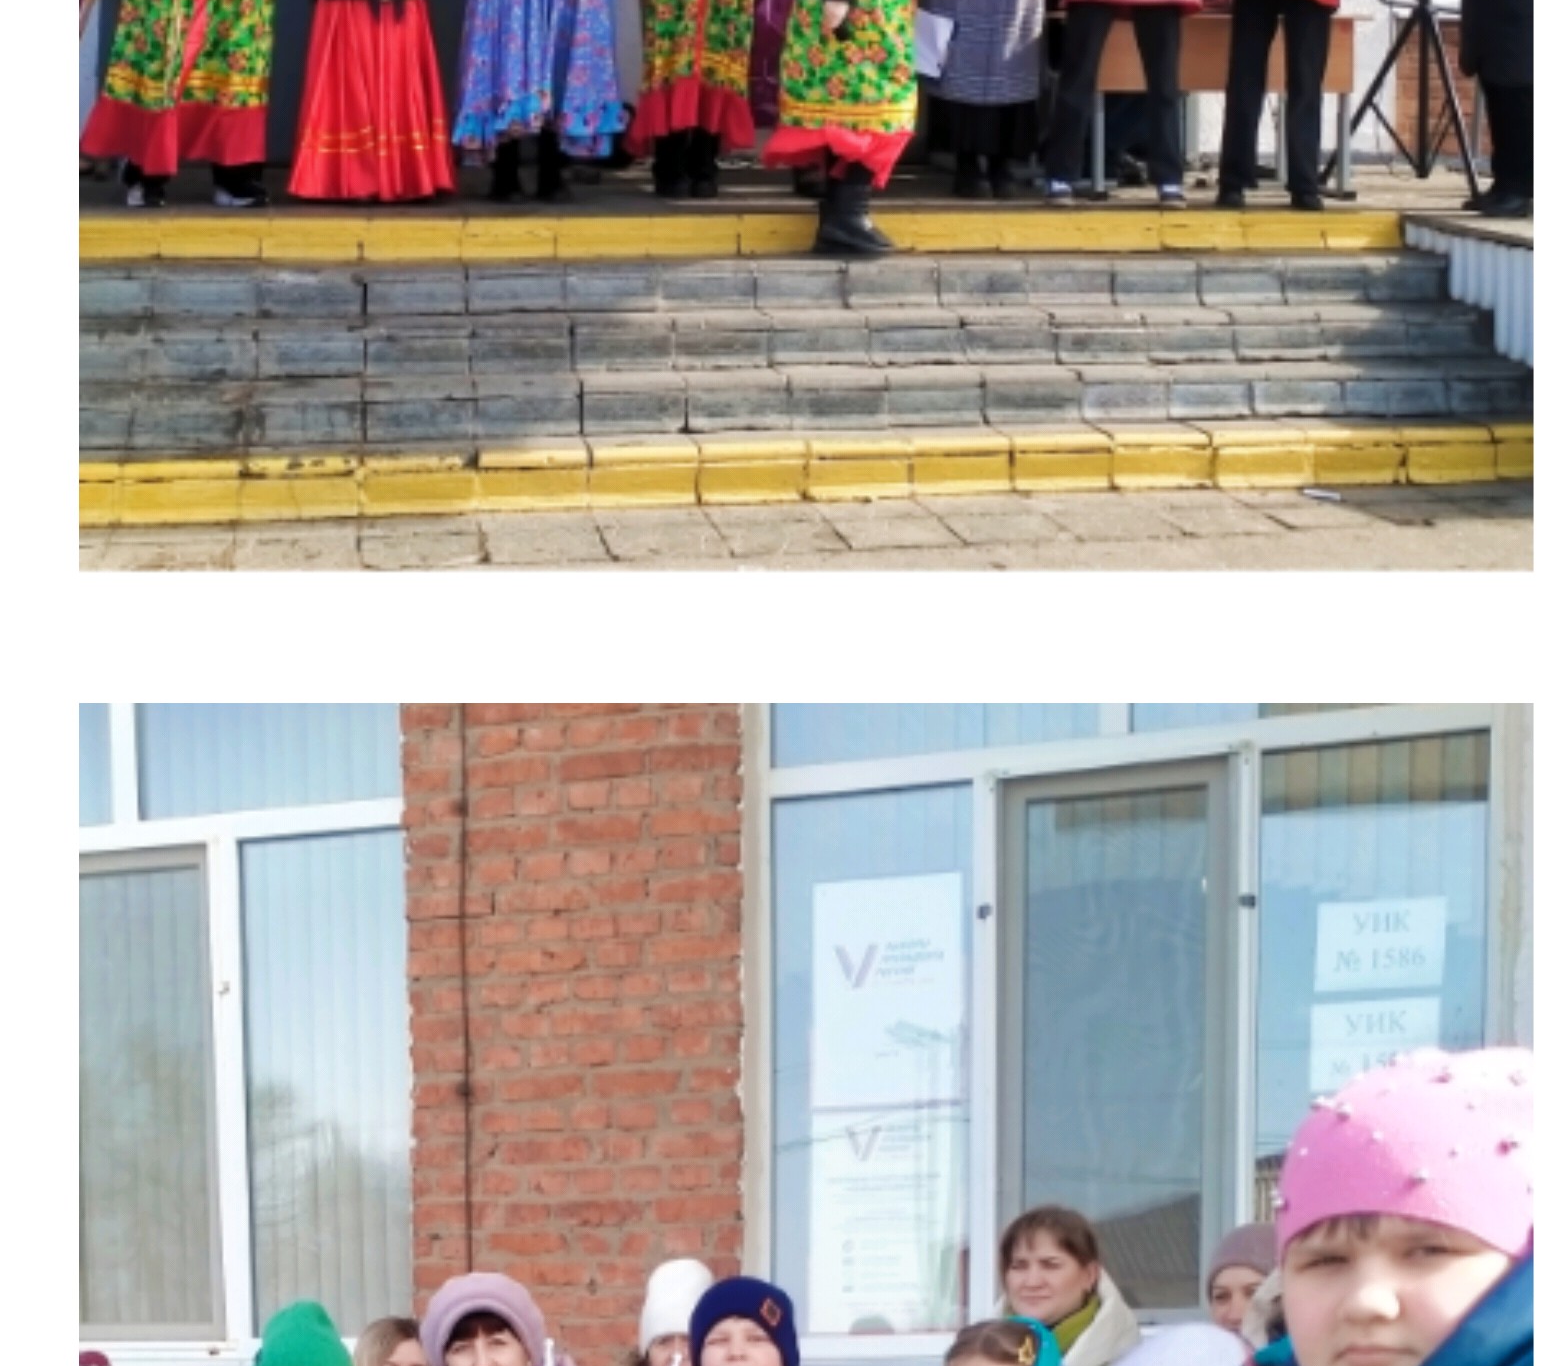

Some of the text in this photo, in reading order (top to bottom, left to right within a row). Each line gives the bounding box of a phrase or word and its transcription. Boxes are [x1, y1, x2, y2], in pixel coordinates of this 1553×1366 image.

[1353, 909, 1411, 936] УИК
[1333, 946, 1427, 973] № 1586
[1346, 1010, 1408, 1036] УИК
